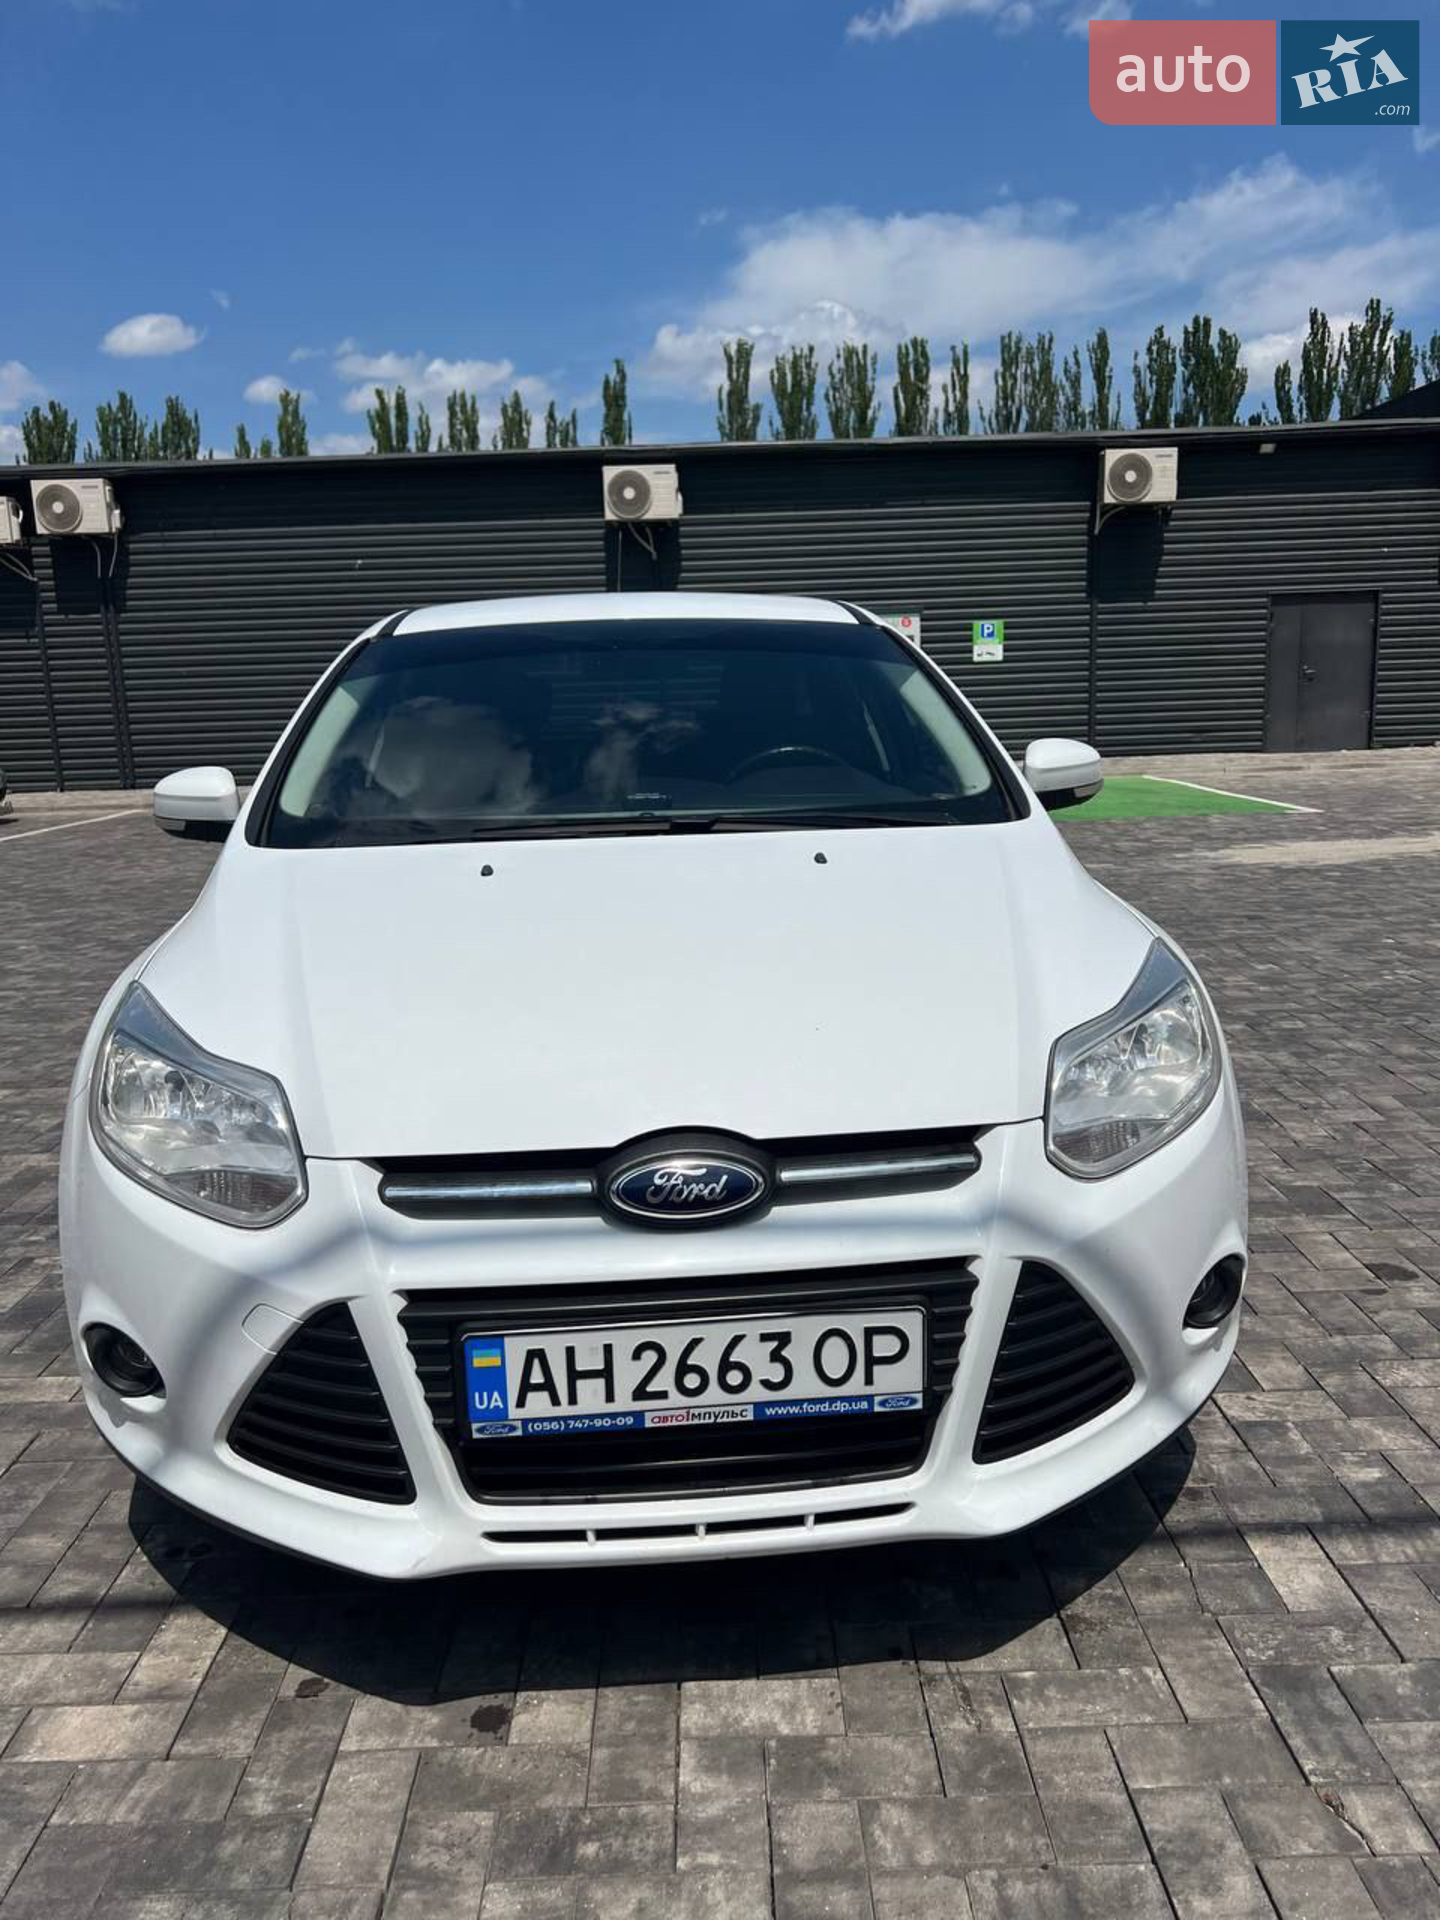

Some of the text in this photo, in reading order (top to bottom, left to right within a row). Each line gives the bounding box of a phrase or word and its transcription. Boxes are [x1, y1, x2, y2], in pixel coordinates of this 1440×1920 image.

[646, 1167, 729, 1203] Ford
[515, 1325, 911, 1409] AH 2663 OP
[474, 1391, 504, 1409] UA
[765, 1400, 869, 1416] www.ford.dp.ua
[527, 1416, 634, 1432] (056) 747-90-09
